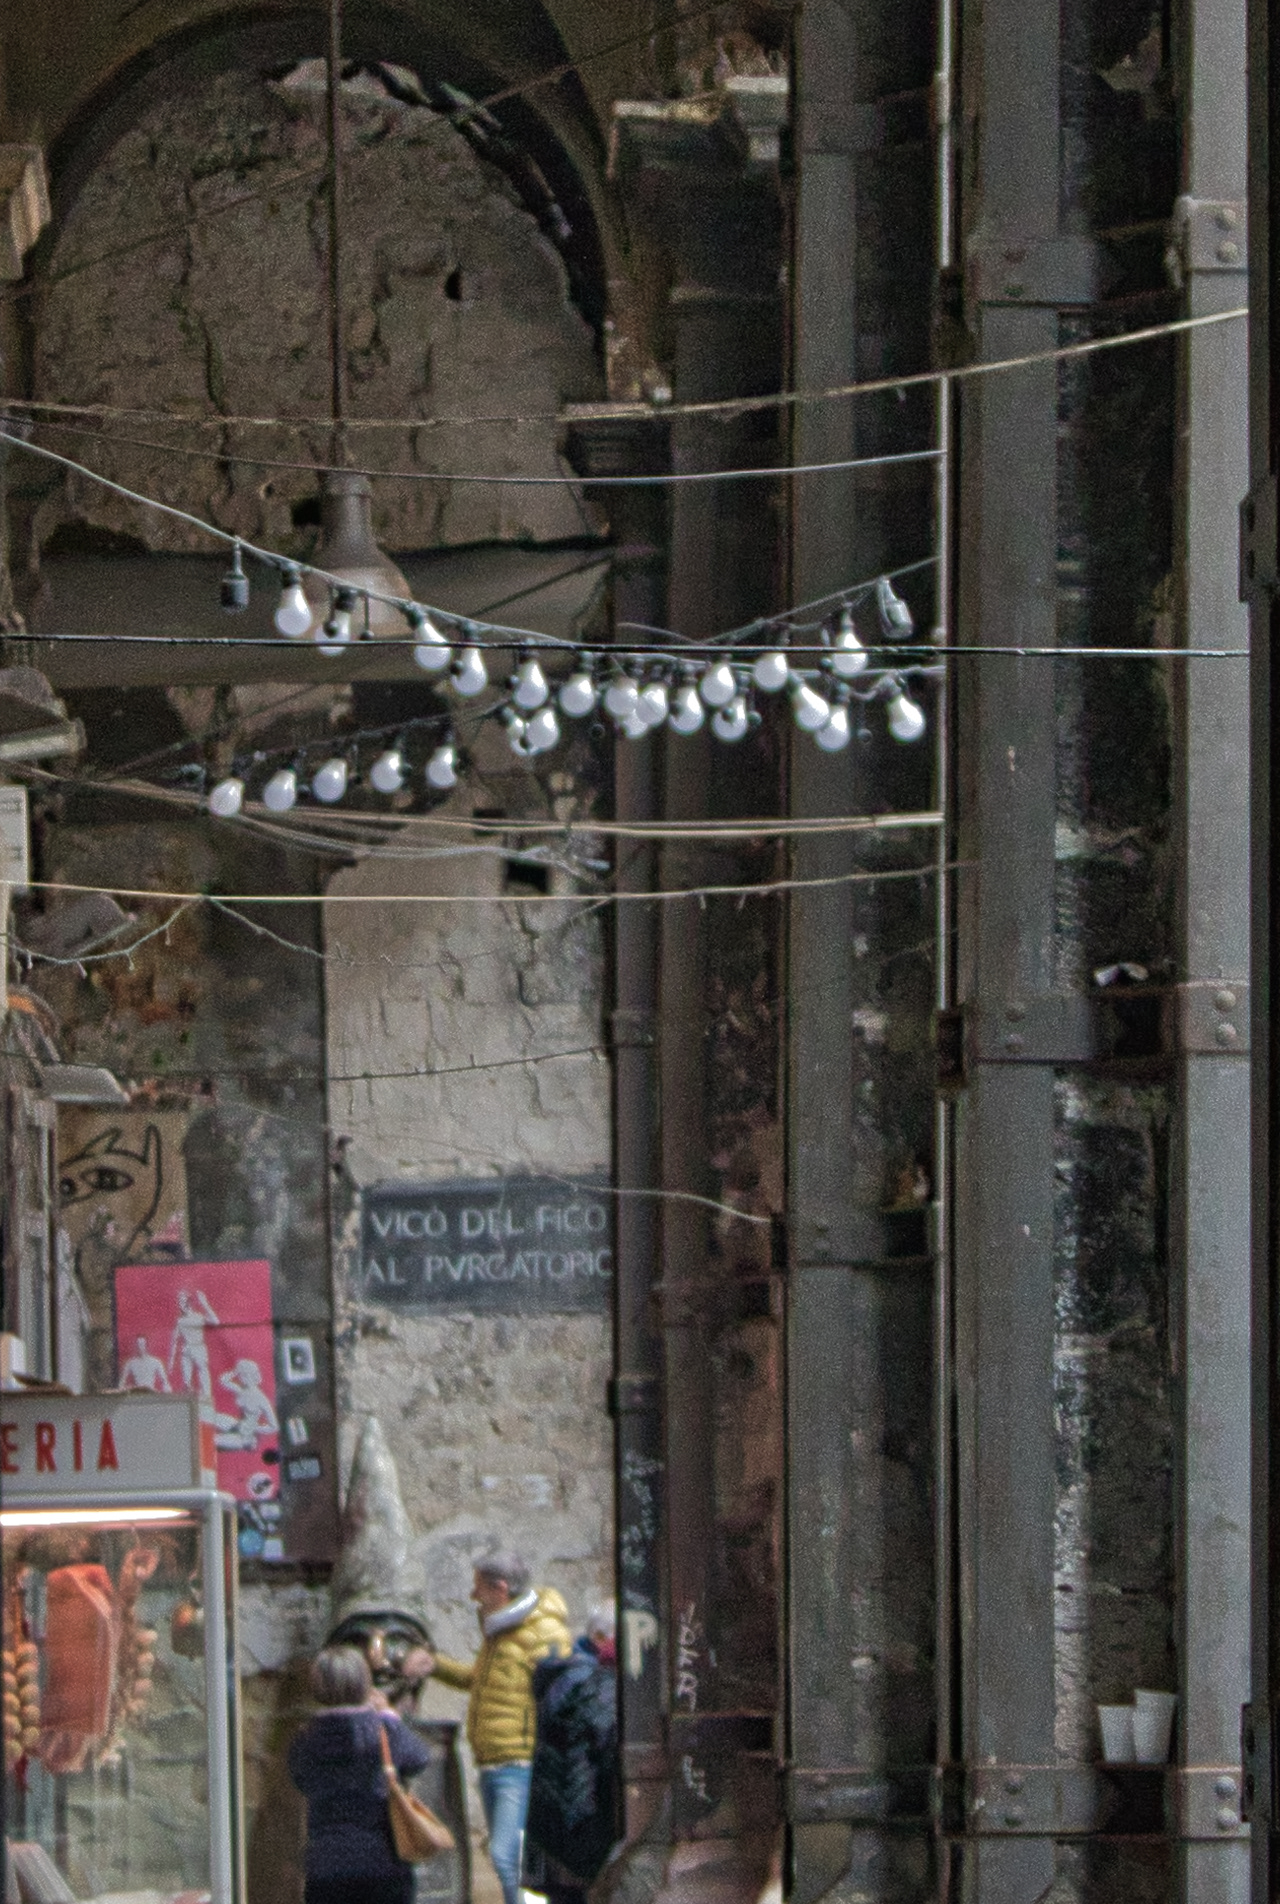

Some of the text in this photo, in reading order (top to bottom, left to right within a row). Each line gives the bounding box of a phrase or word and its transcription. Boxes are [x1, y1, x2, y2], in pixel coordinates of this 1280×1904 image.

[371, 1204, 607, 1239] VICO DEL FICO
[365, 1257, 408, 1286] AL
